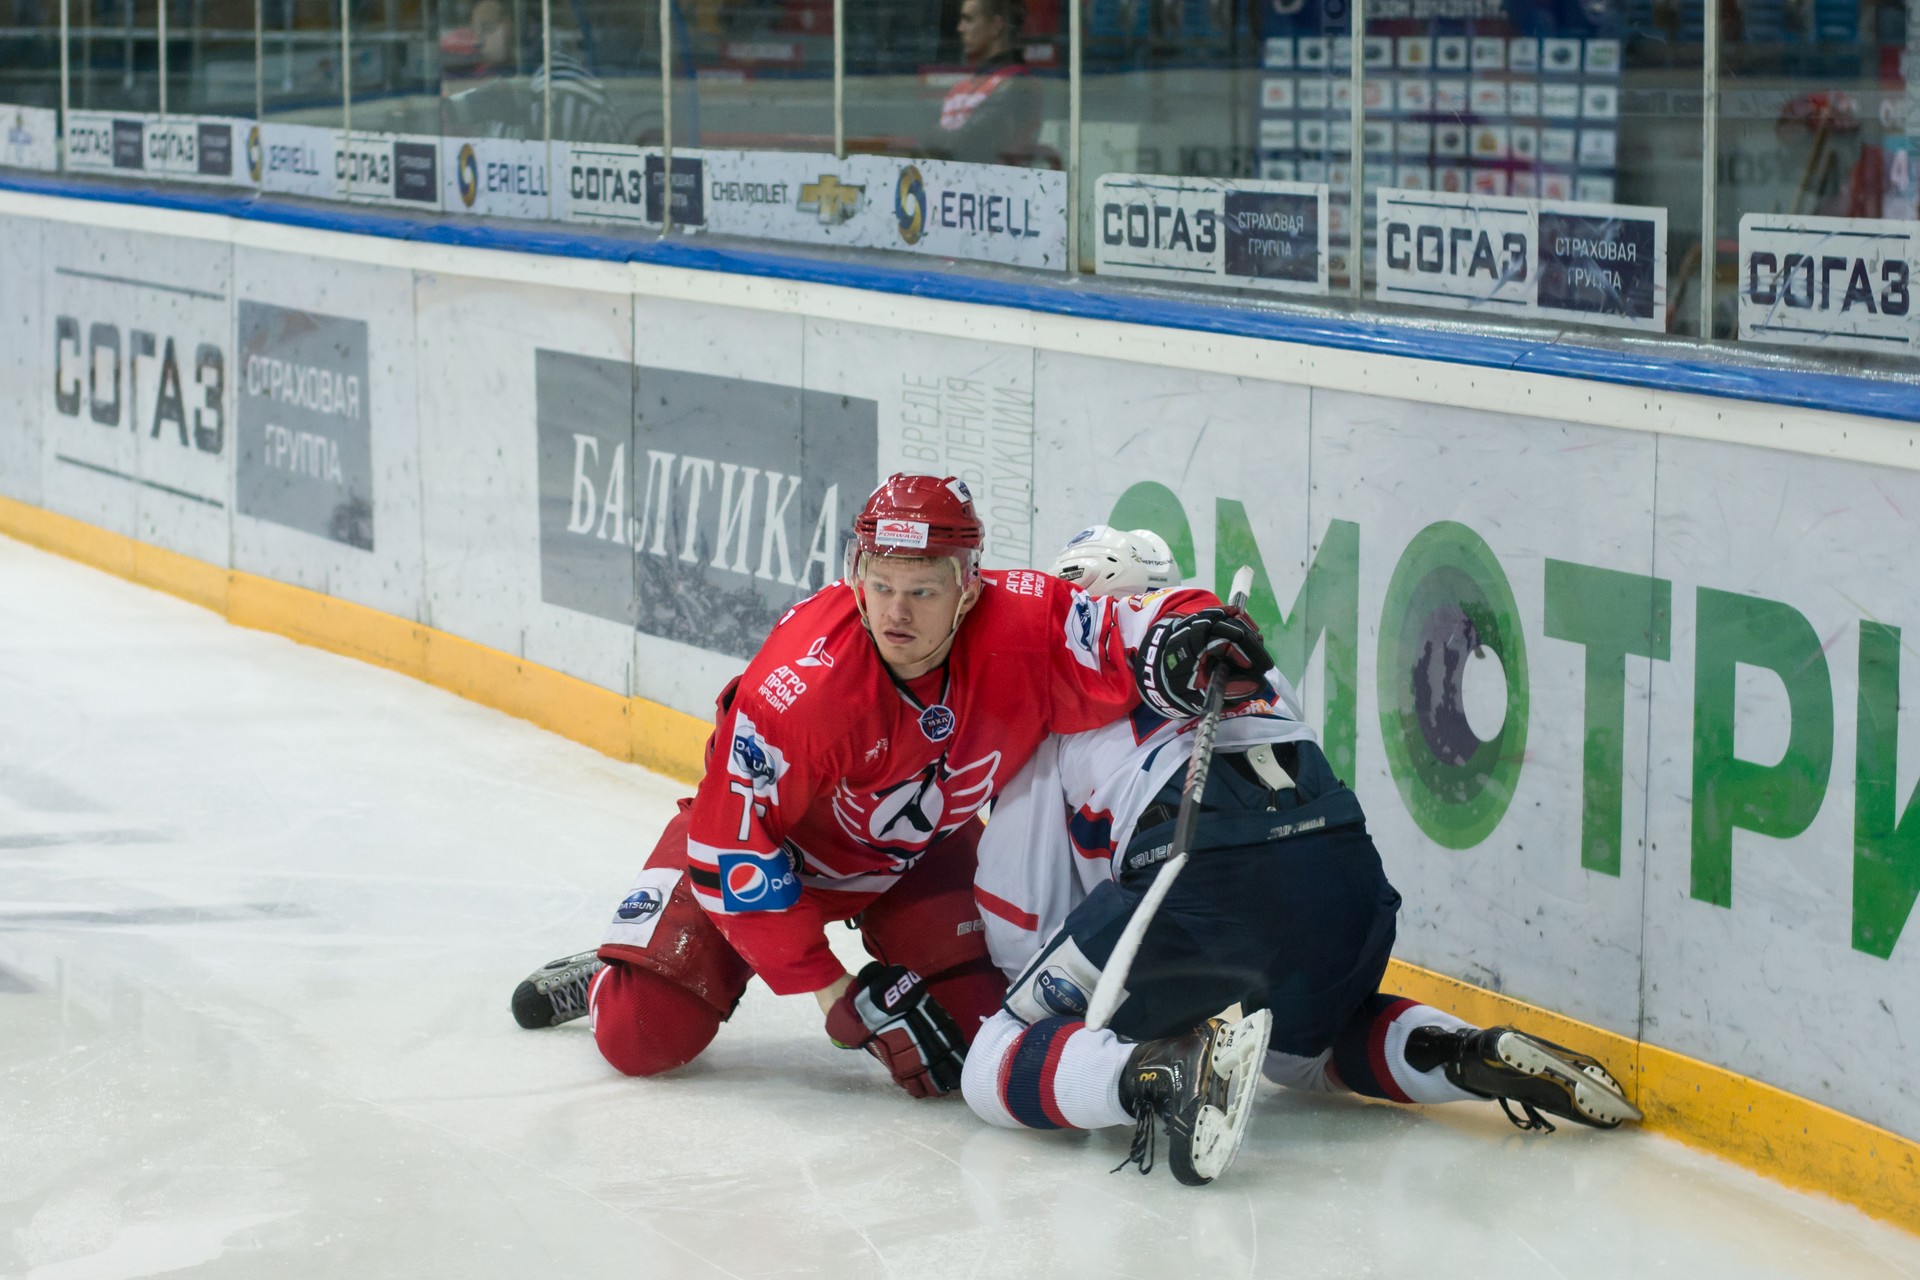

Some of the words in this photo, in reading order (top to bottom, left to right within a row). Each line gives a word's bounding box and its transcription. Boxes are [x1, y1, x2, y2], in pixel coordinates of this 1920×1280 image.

[487, 162, 549, 197] ERIELL
[571, 166, 641, 204] СОГАЗ
[711, 181, 789, 204] CHEVROLET
[940, 190, 1041, 239] ERIELL
[1103, 203, 1217, 253] СОГАЗ
[1238, 211, 1304, 233] СТРАХОВАЯ
[1248, 237, 1293, 257] ГРУППА
[1386, 222, 1528, 283] СОГАЗ
[1555, 236, 1637, 263] СТРАХОВАЯ
[1750, 251, 1910, 316] СОГАЗ
[55, 314, 225, 456] СОГАЗ
[246, 353, 360, 421] СТРАХОВАЯ
[902, 373, 941, 463] ВРЕДЕ
[946, 376, 985, 500] БЛЕНИЯ
[265, 423, 343, 485] ГРУППА
[990, 386, 1034, 564] ПРОДУКЦИИ
[567, 433, 839, 590] БАЛТИКА
[878, 531, 924, 540] FORWARD
[758, 685, 788, 714] КРЕДИТ
[764, 673, 797, 707] ПРОМ
[773, 665, 807, 694] АГРО
[1041, 975, 1087, 1013] DATSU
